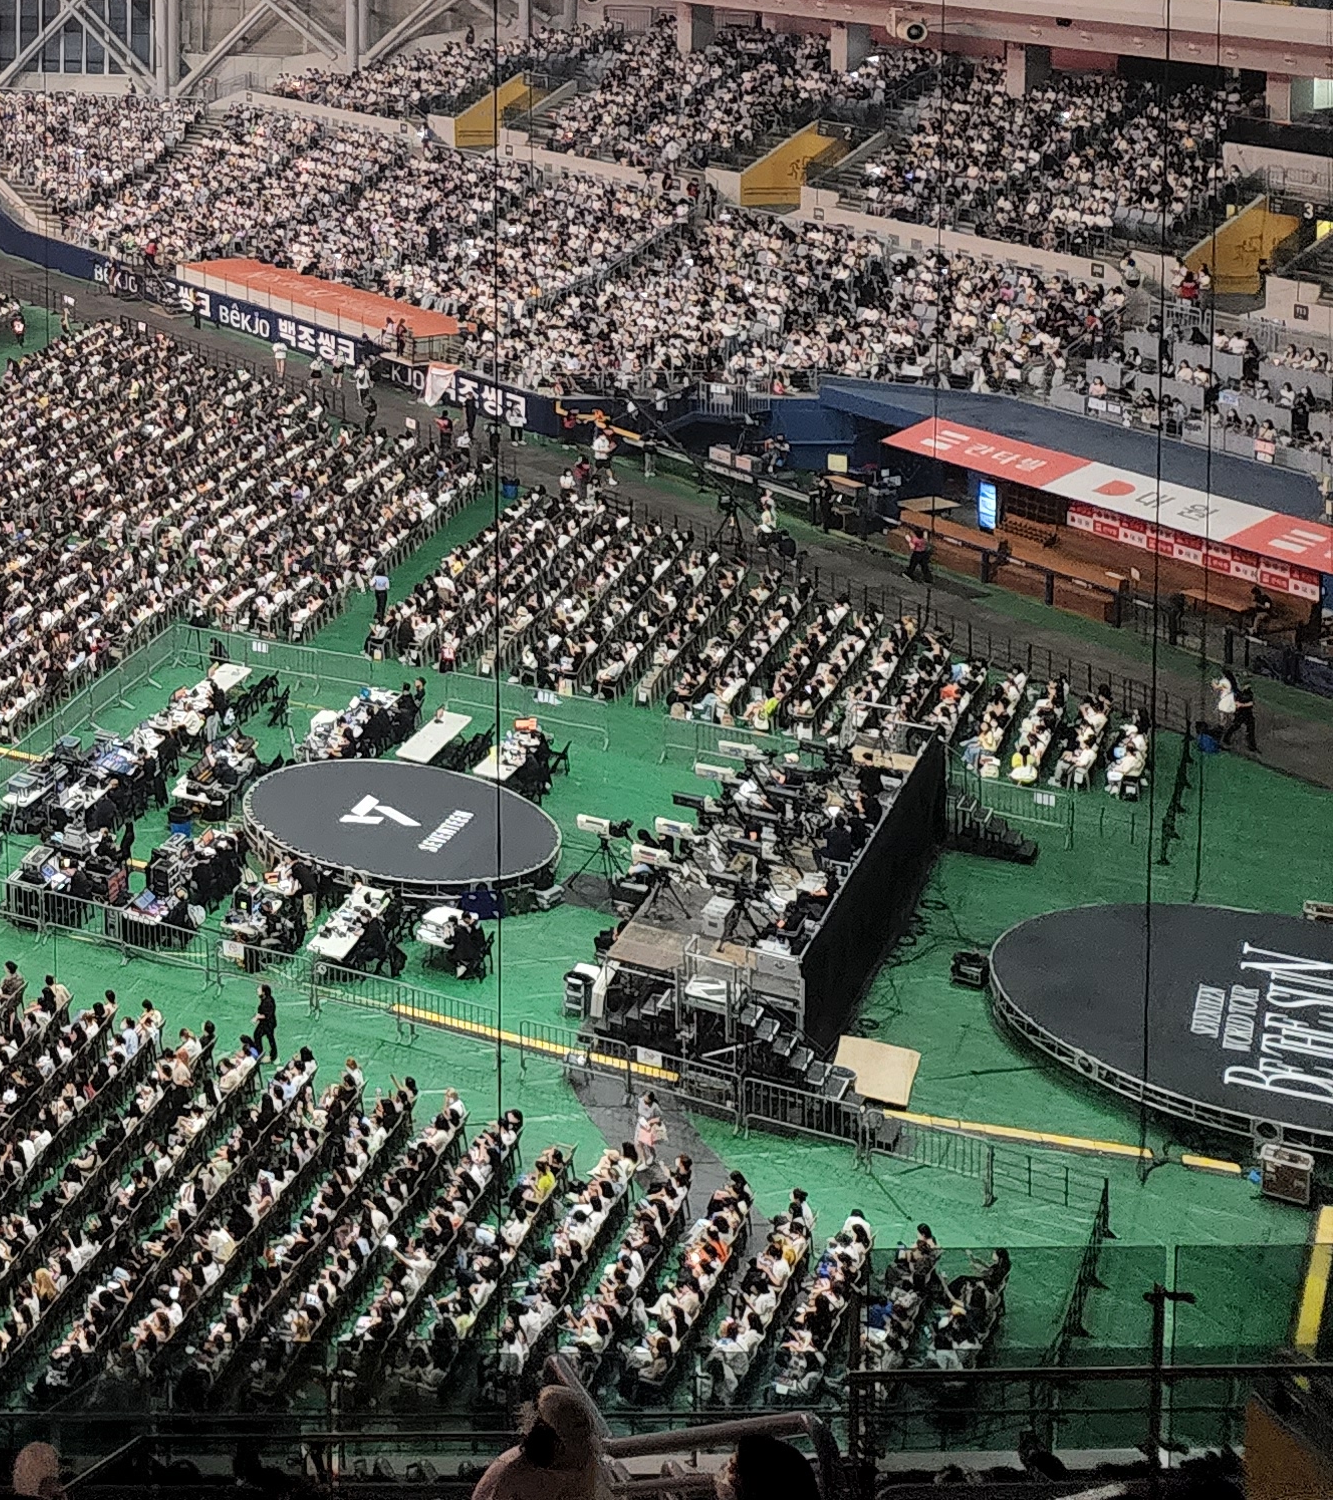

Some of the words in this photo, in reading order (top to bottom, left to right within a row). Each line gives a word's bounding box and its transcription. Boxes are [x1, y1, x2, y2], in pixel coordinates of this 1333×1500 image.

[843, 126, 852, 140] 2
[1303, 202, 1314, 219] 3
[279, 318, 356, 366] 백조씽크
[418, 809, 475, 853] SEVENTEEN
